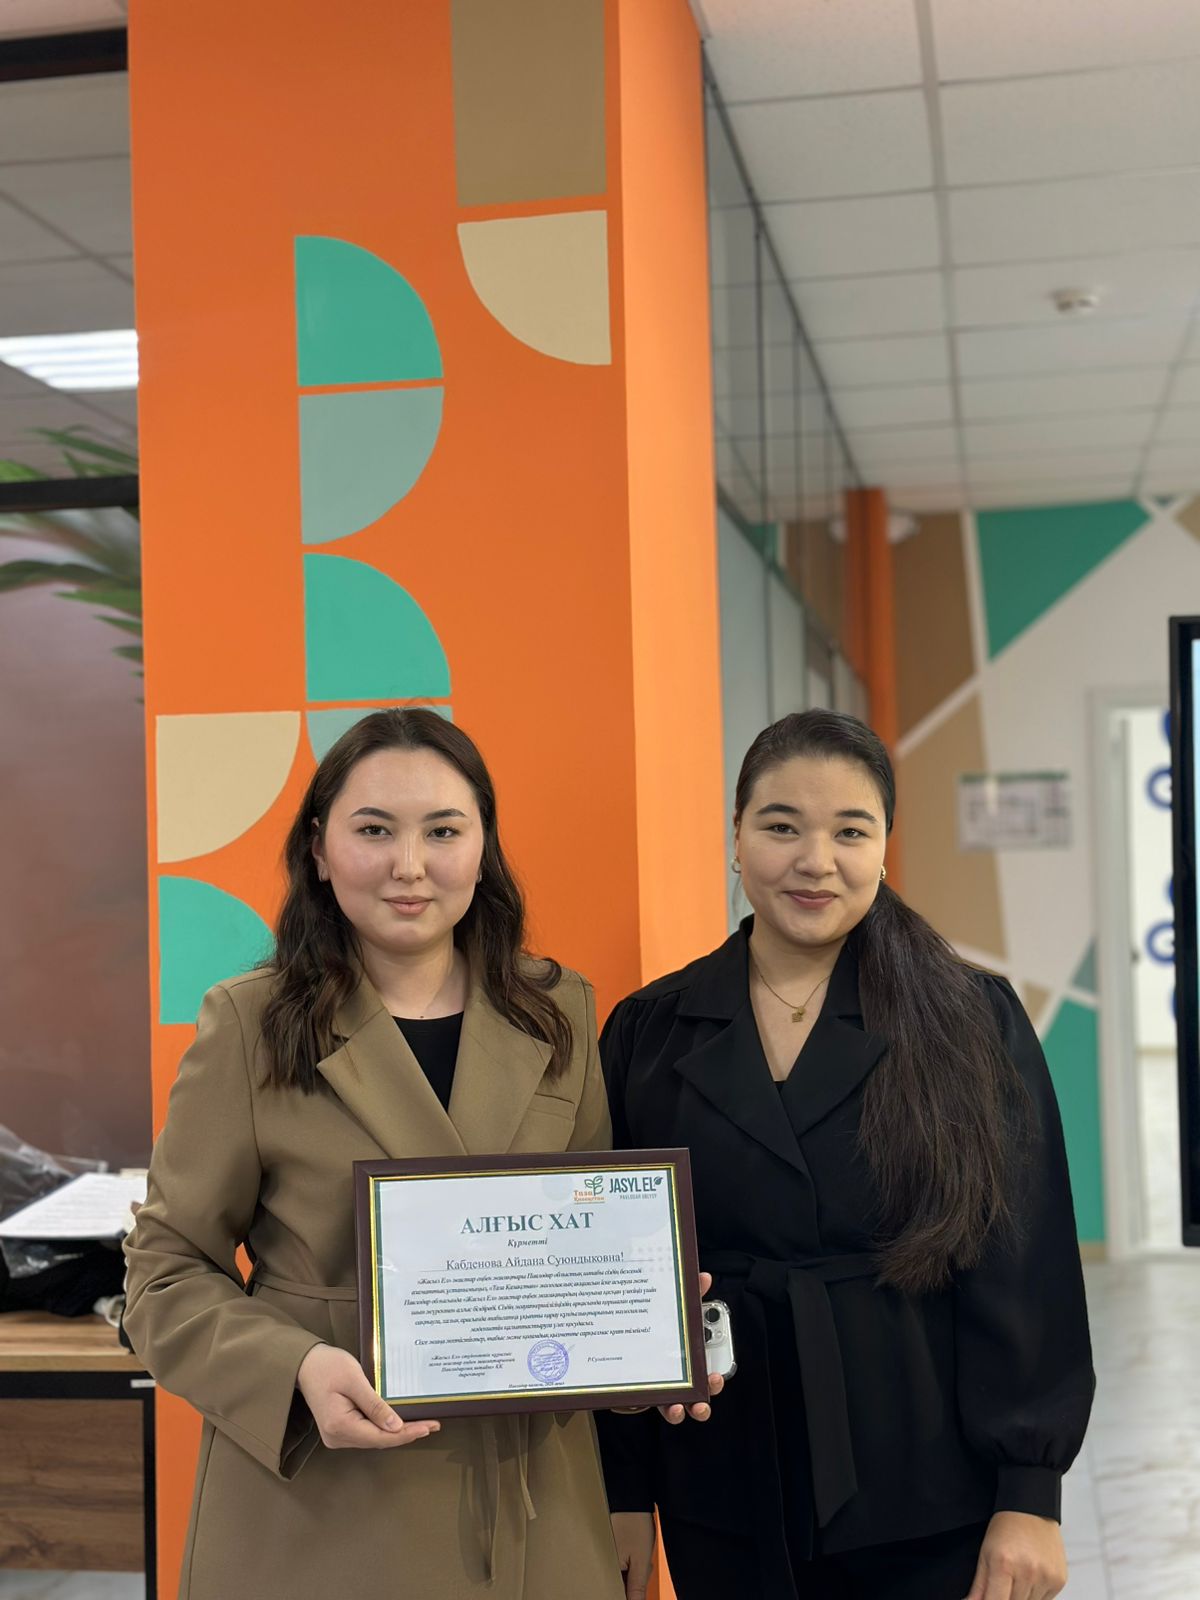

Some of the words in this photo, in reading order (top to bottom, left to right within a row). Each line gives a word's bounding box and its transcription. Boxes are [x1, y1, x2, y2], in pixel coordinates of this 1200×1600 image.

[609, 1177, 641, 1193] JASYL
[642, 1177, 656, 1192] EL
[460, 1214, 543, 1234] АЛҒЫС
[549, 1212, 594, 1230] ХАТ
[507, 1237, 548, 1248] Құрметті
[446, 1259, 502, 1271] Кабденова
[505, 1257, 544, 1268] Айдана
[547, 1252, 624, 1267] Суюндыковна!
